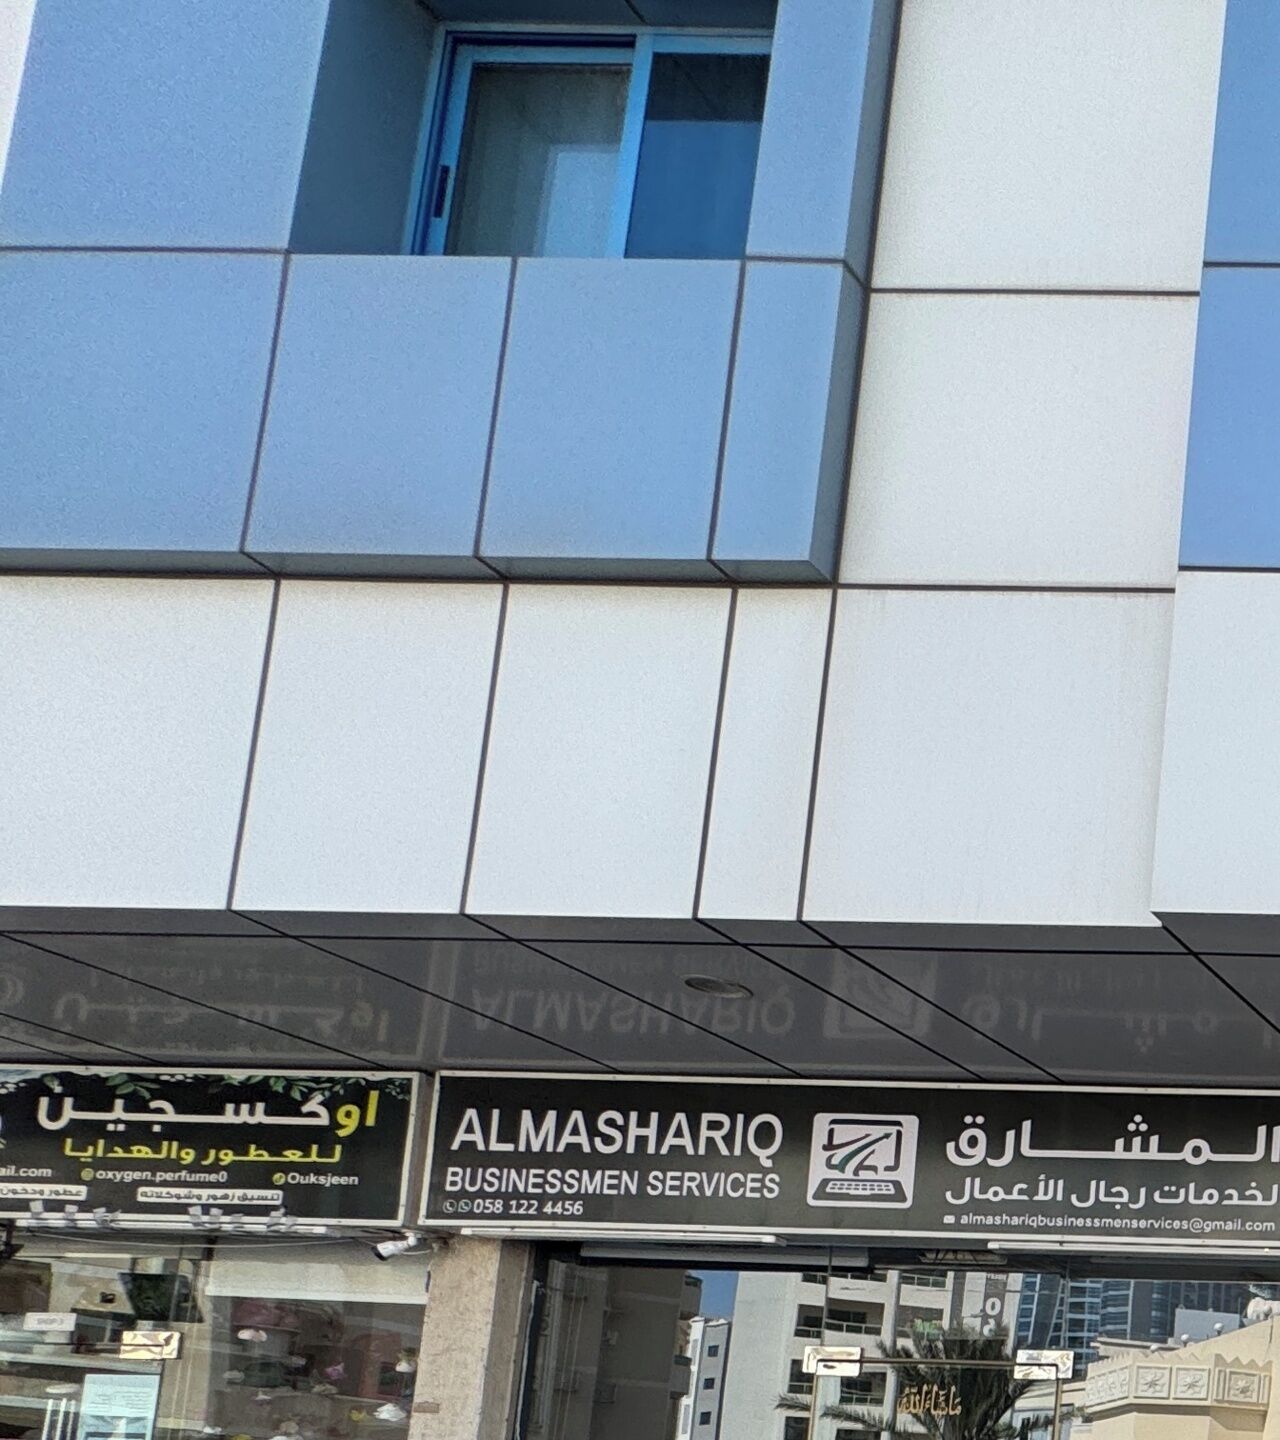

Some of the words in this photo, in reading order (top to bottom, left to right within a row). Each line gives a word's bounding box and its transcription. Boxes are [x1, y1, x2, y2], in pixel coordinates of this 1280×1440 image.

[63, 1137, 196, 1166] والهدايا
[450, 1107, 784, 1168] ALMASHARIQ
[287, 1172, 359, 1187] Ouksjeen
[444, 1167, 639, 1196] BUSINESSMEN
[646, 1170, 781, 1199] SERVICES
[945, 1174, 1064, 1206] الأعمال
[1152, 1181, 1280, 1207] لخدمات
[473, 1199, 503, 1215] 058
[509, 1200, 538, 1215] 122
[543, 1200, 584, 1216] 4456
[1070, 1180, 1147, 1209] رجال
[960, 1212, 1276, 1233] almashariqbusinessmenservices@gmail.com
